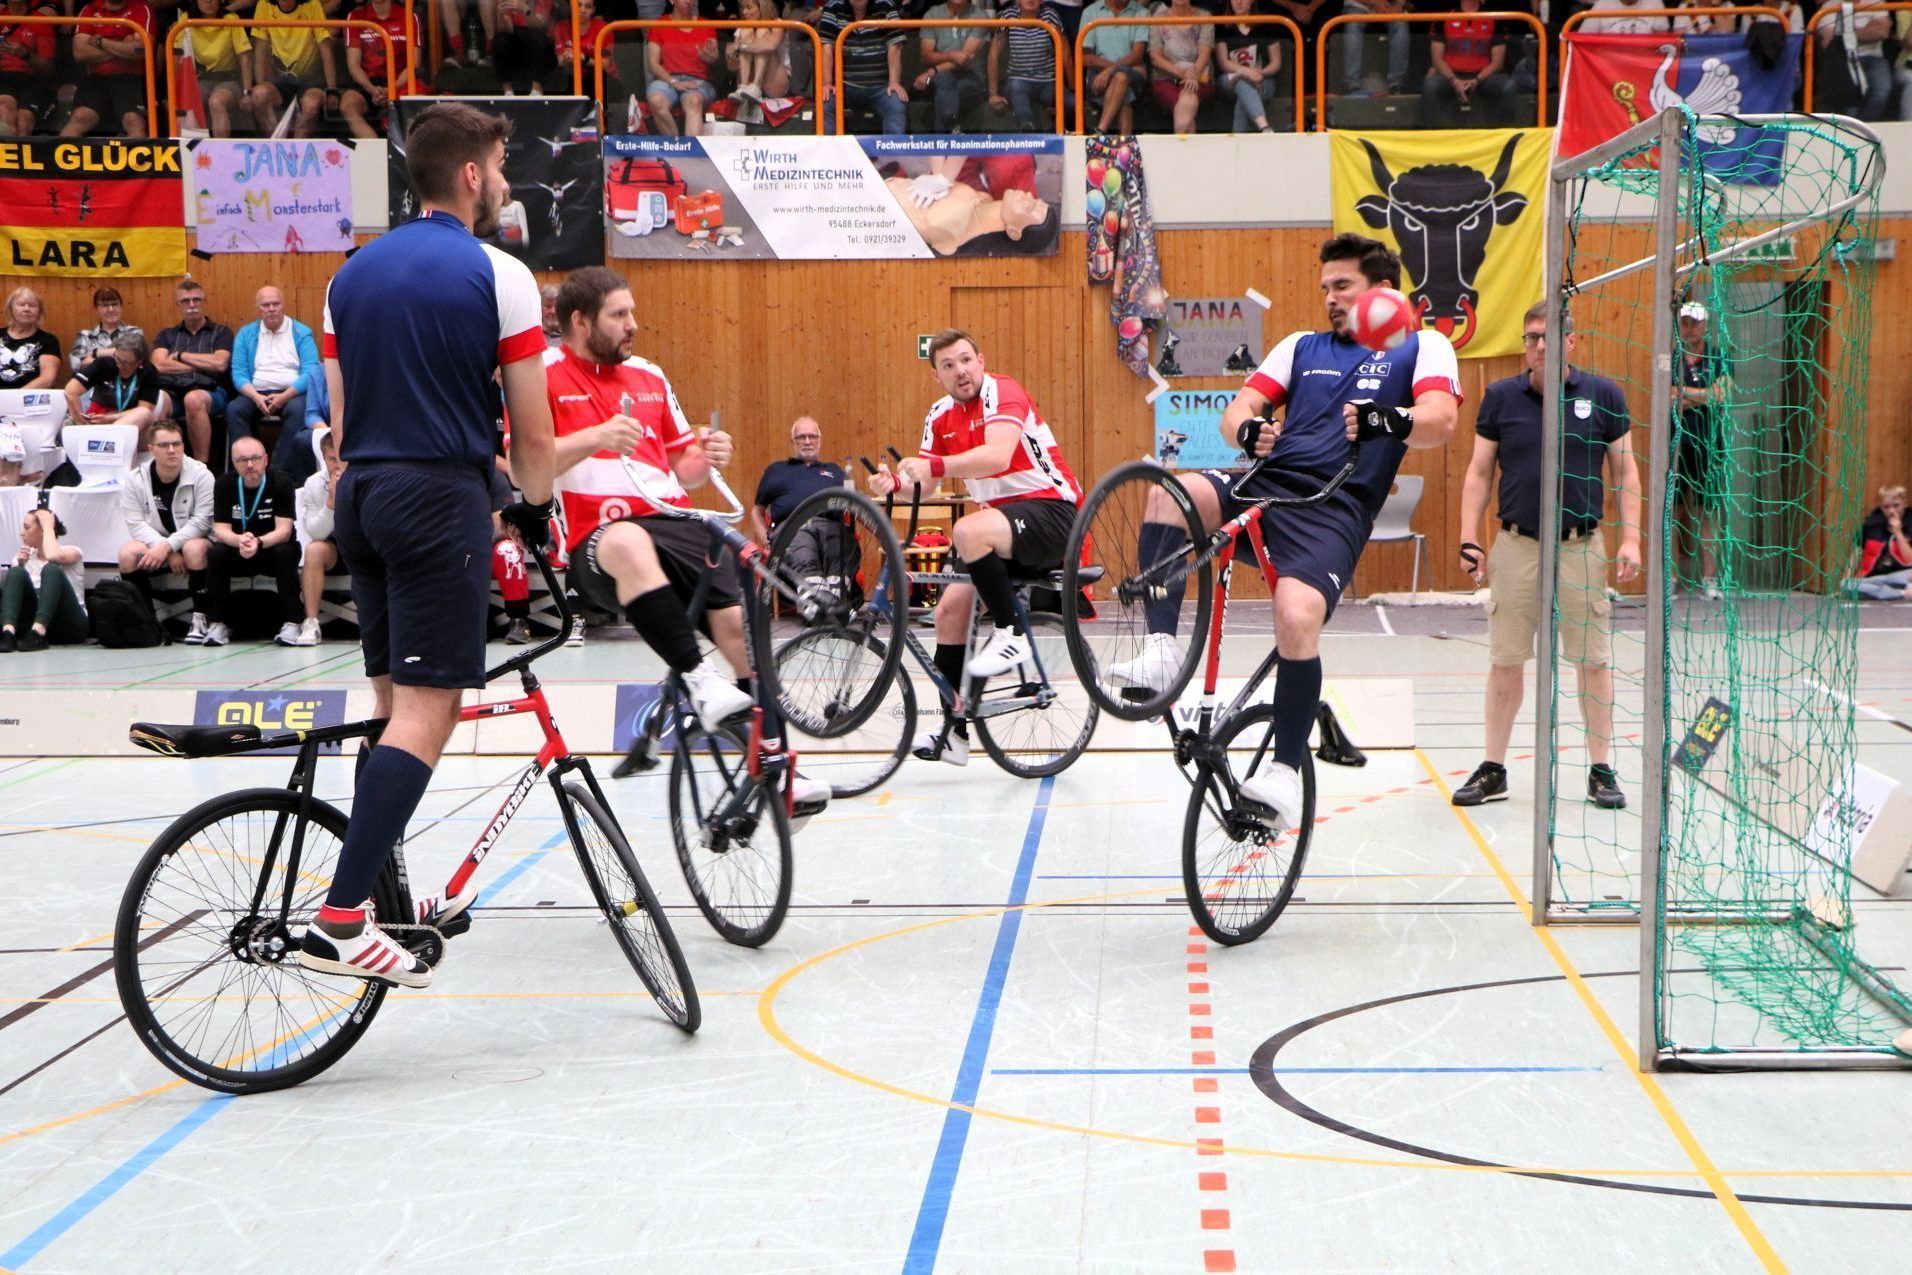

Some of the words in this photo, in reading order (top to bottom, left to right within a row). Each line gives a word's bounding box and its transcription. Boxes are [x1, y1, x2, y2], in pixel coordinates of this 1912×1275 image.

[615, 141, 692, 152] Erste-Hilfe-Bedarf
[876, 140, 935, 150] Fachwerkstatt
[936, 140, 948, 150] für
[950, 139, 1046, 151] Reanimationsphantome
[54, 140, 181, 172] GLÜCK
[753, 149, 797, 164] WIRTH
[233, 142, 322, 184] JANA
[753, 166, 864, 181] MEDIZINTECHNIK
[753, 182, 779, 191] ERSTE
[784, 182, 809, 190] HILFE
[813, 181, 833, 190] UND
[838, 181, 864, 190] MEHR
[245, 188, 342, 224] Monsterstark
[772, 205, 886, 214] www.wirth-medizintechnik.de
[828, 220, 852, 228] 95488
[854, 219, 896, 228] Eckersdorf
[864, 234, 906, 244] 0921/39329
[11, 239, 130, 268] LARA
[1172, 301, 1247, 329] JANA
[1358, 364, 1387, 374] CIC
